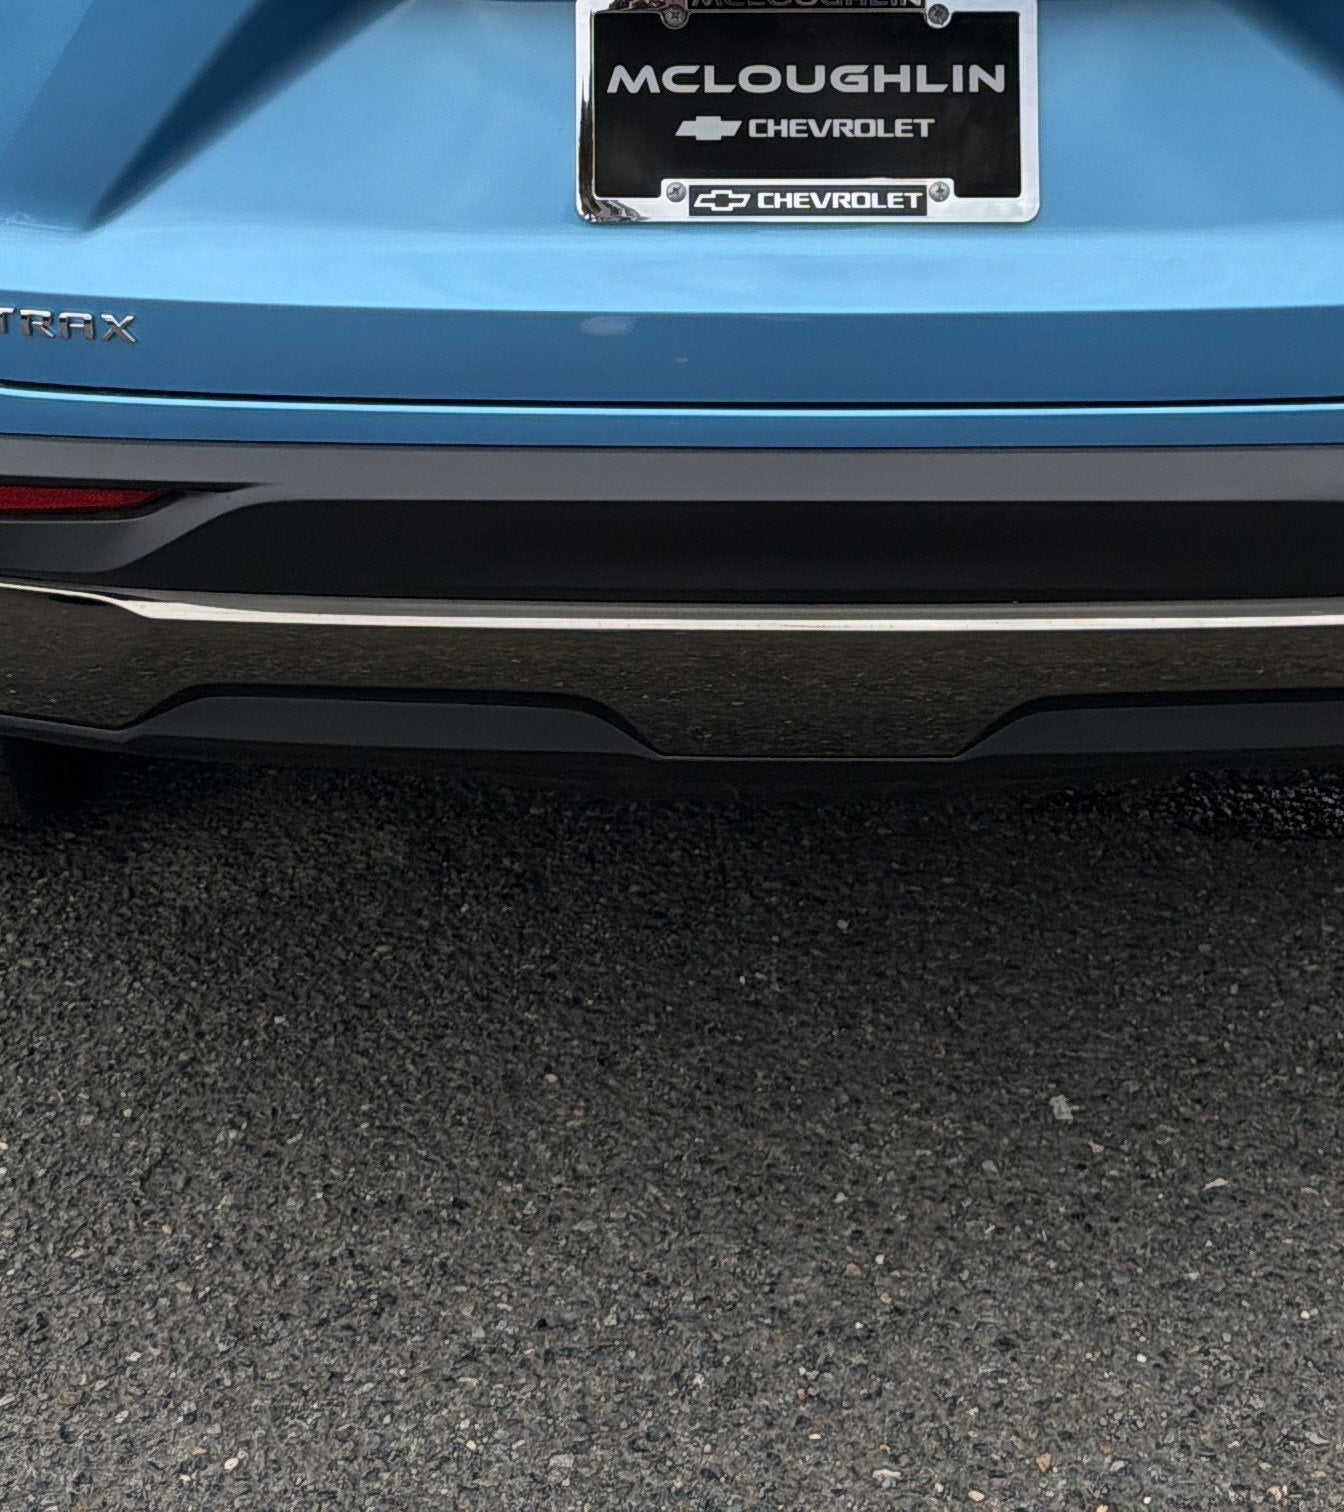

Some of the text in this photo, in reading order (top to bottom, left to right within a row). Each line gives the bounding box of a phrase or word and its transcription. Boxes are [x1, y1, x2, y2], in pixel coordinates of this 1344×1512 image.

[606, 64, 1005, 94] MCLOUGHLIN
[748, 118, 935, 138] CHEVROLET
[757, 191, 923, 210] CHEVROLET
